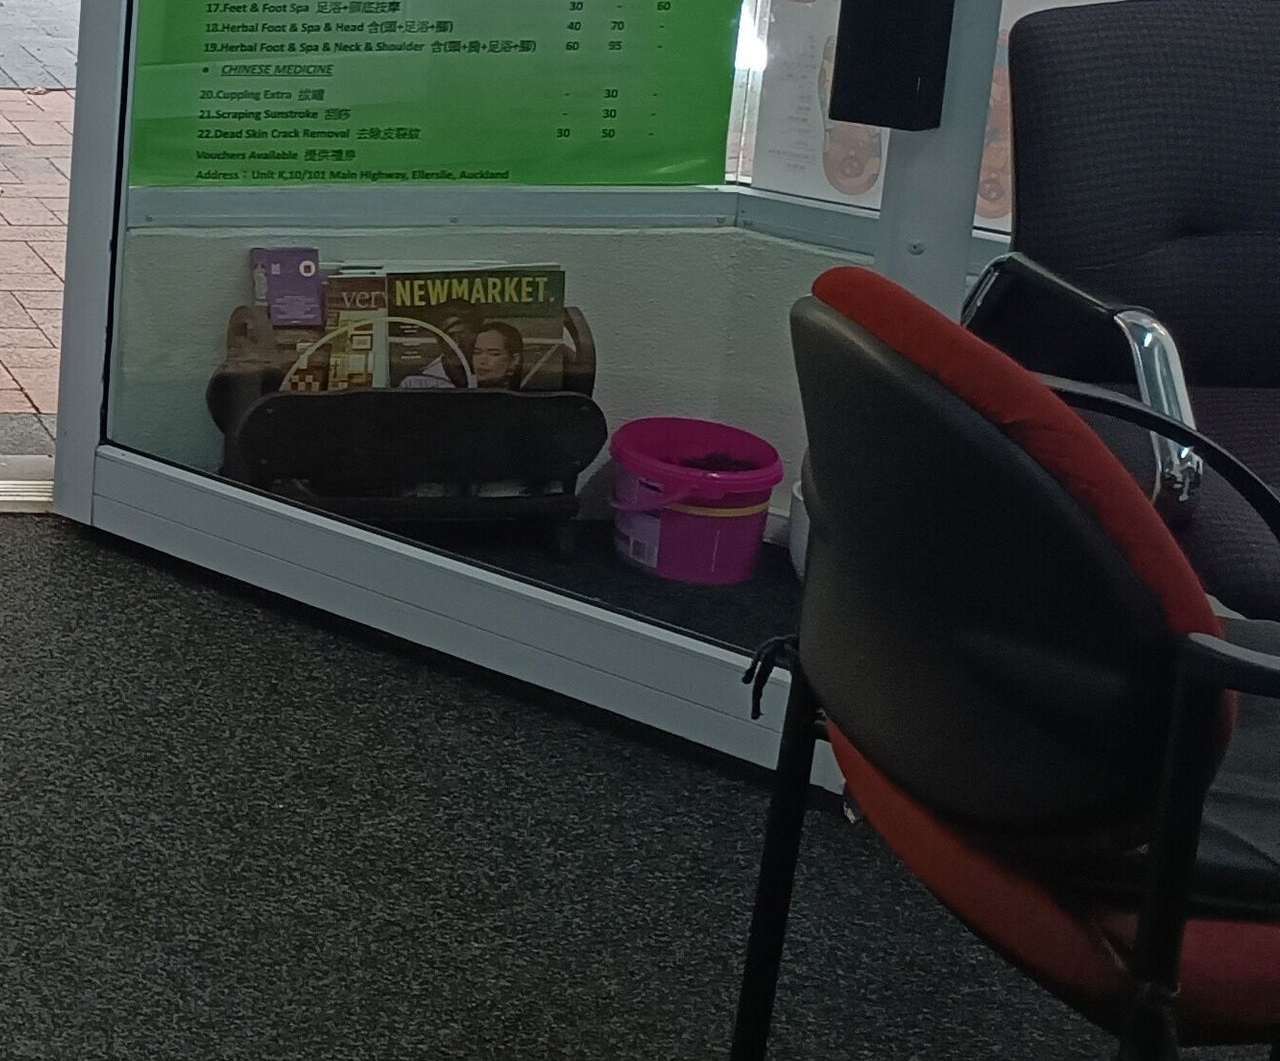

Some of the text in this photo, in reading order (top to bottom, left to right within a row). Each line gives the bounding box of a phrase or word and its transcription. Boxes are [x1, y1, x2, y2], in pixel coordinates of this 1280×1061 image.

[261, 3, 309, 15] Foot Spa
[570, 1, 671, 11] 30 60
[261, 22, 364, 34] Foot Spa Head
[567, 21, 625, 31] 40 70
[260, 41, 425, 54] Foot Spa Neck Shoulder
[566, 41, 622, 51] 60 95
[222, 64, 333, 75] CHINESE MEDICINE
[263, 90, 292, 100] Extra
[604, 89, 618, 98] 30
[264, 109, 318, 120] Sunstroke
[602, 109, 616, 118] 30
[246, 128, 350, 139] Skin Crack Removal
[556, 129, 615, 138] 30 50
[196, 150, 298, 161] Vouchers Available
[251, 169, 509, 180] Unit Main Auckland
